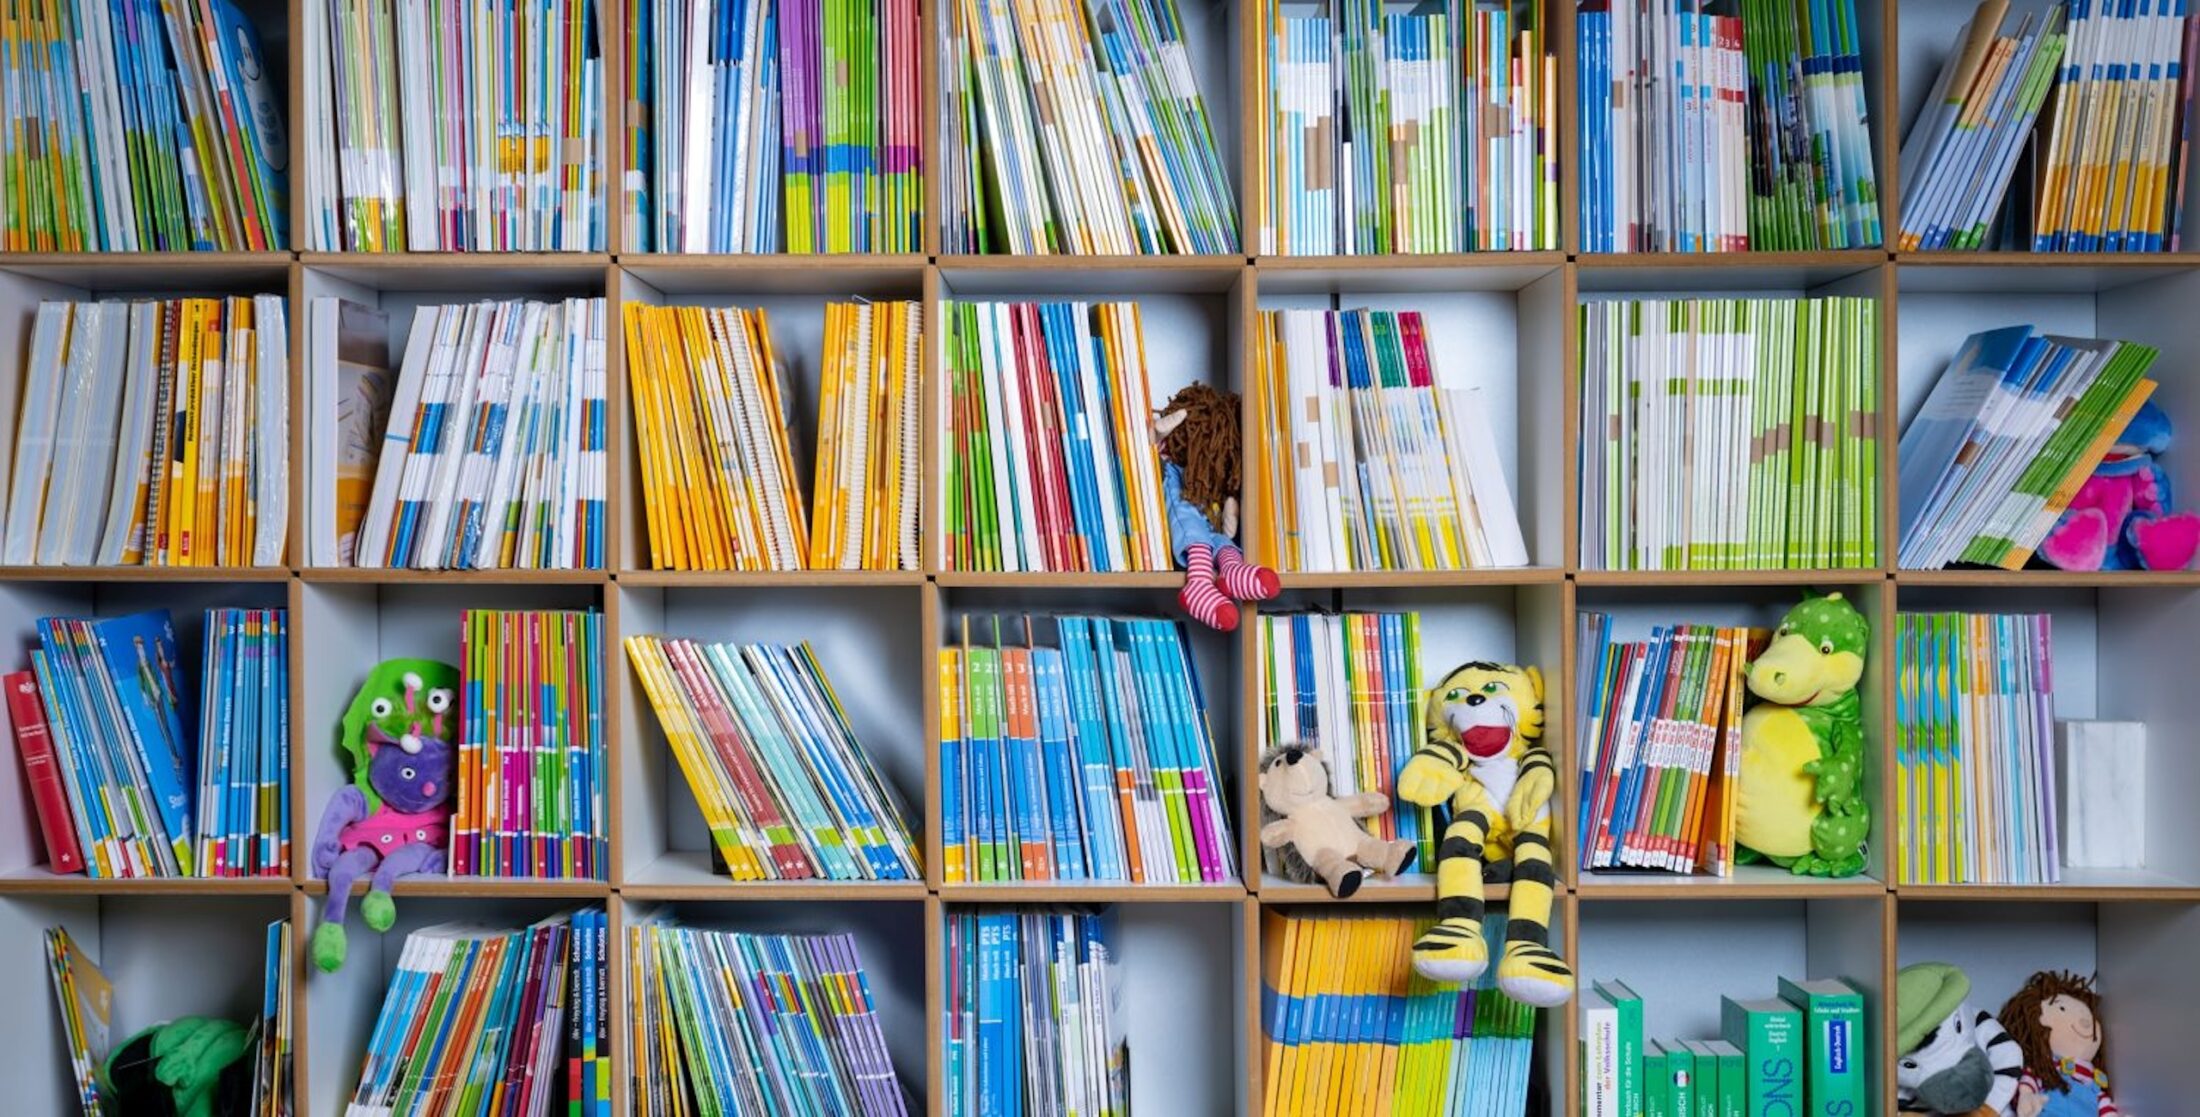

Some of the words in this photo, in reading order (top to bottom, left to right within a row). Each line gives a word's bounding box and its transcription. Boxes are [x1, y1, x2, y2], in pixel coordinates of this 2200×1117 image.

[981, 926, 990, 945] PTS
[991, 926, 1000, 945] PTS
[1003, 925, 1011, 941] PTS
[1603, 1022, 1611, 1074] Volksschule
